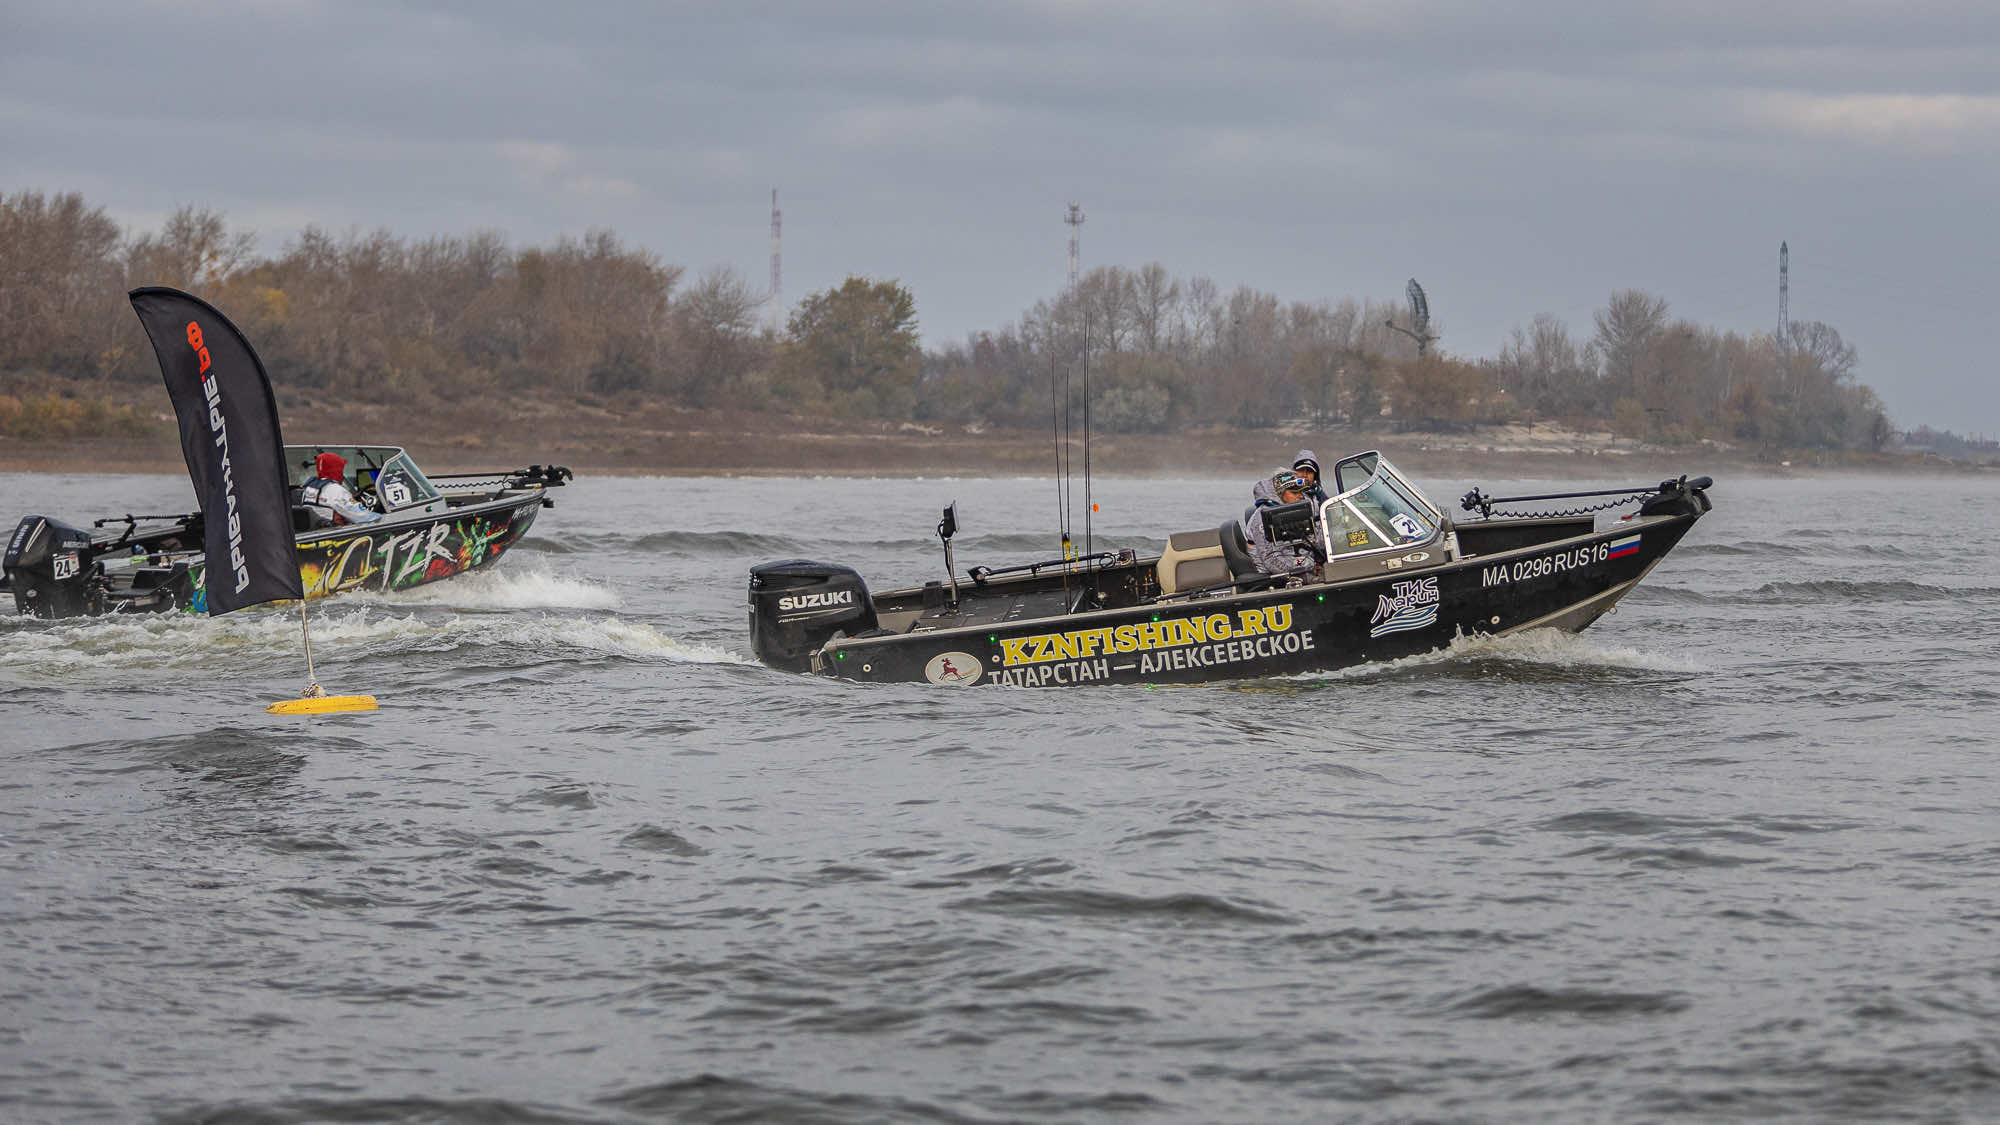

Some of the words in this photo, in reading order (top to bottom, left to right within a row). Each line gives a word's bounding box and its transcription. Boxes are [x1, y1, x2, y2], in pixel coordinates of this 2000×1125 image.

[393, 489, 405, 502] 51
[55, 560, 71, 577] 24
[1482, 566, 1510, 587] MA
[1513, 556, 1552, 581] 0296
[1554, 542, 1609, 573] RUS16
[778, 590, 853, 610] SUZUKI
[1392, 576, 1438, 598] ТИС
[1370, 589, 1440, 623] Марин
[1000, 604, 1293, 667] KZNFISHING.RU
[987, 657, 1110, 688] ТАТАРСТАН
[1140, 630, 1315, 674] АЛЕКСЕЕВСКОЕ
